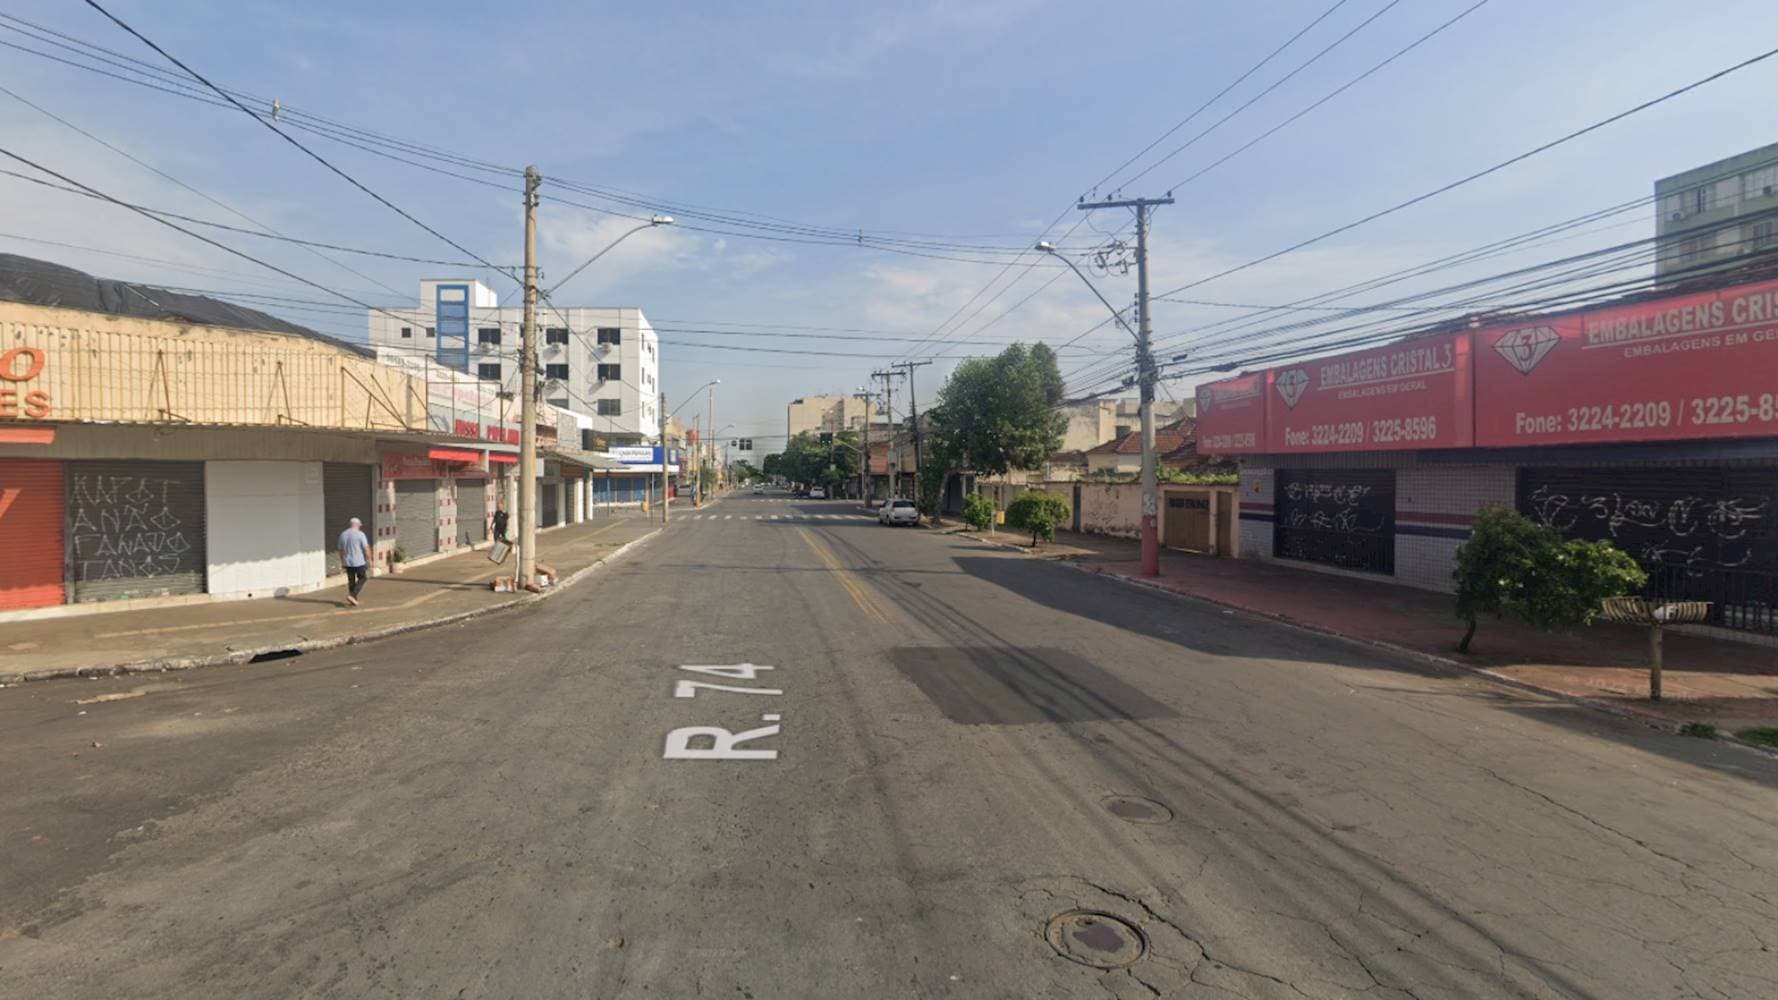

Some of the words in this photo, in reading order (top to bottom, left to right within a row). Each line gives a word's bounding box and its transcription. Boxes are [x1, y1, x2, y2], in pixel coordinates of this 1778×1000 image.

[1588, 301, 1724, 343] EMBALAGENS
[1624, 336, 1721, 357] EMBALAGENS
[1725, 333, 1749, 346] EM
[1752, 329, 1778, 342] GE
[0, 347, 45, 382] O
[1321, 357, 1388, 386] EMBALAGENS
[1391, 347, 1440, 375] CRISTAL
[0, 389, 49, 417] ES
[1516, 412, 1562, 433] Fone:
[1568, 401, 1671, 431] 3224-2209
[1691, 393, 1778, 424] 3225-8
[1285, 428, 1308, 446] Fone:
[1312, 422, 1364, 445] 3224-2209
[1373, 416, 1436, 443] 3225-8596
